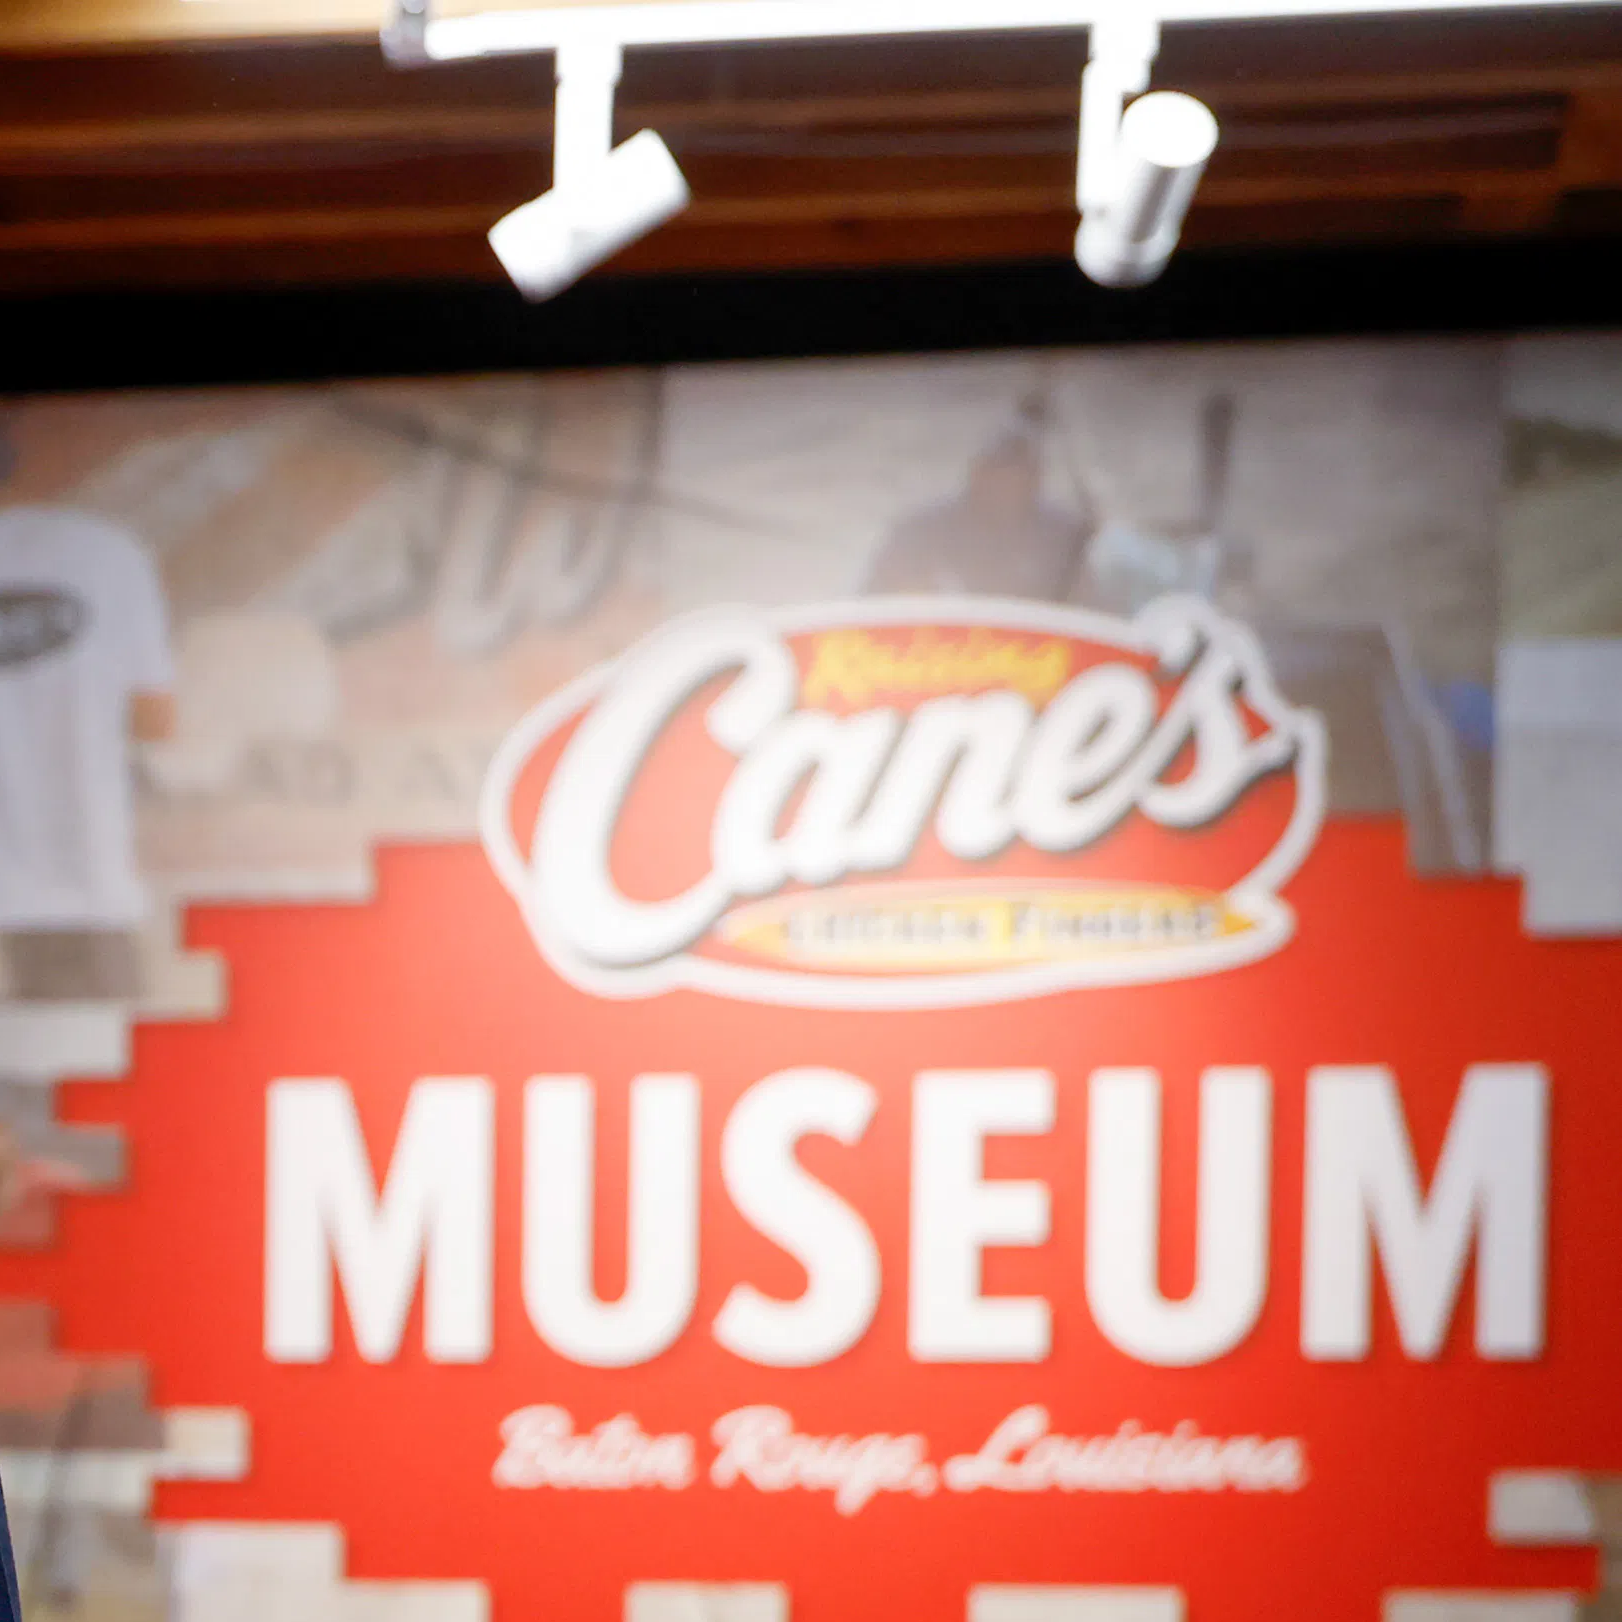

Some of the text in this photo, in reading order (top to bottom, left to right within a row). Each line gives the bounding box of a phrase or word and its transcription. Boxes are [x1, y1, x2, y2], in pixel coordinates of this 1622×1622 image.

[531, 606, 1295, 968] Cane's
[263, 1062, 1549, 1368] MUSEUM
[491, 1403, 1309, 1517] Baton Rouge, Louisiana
